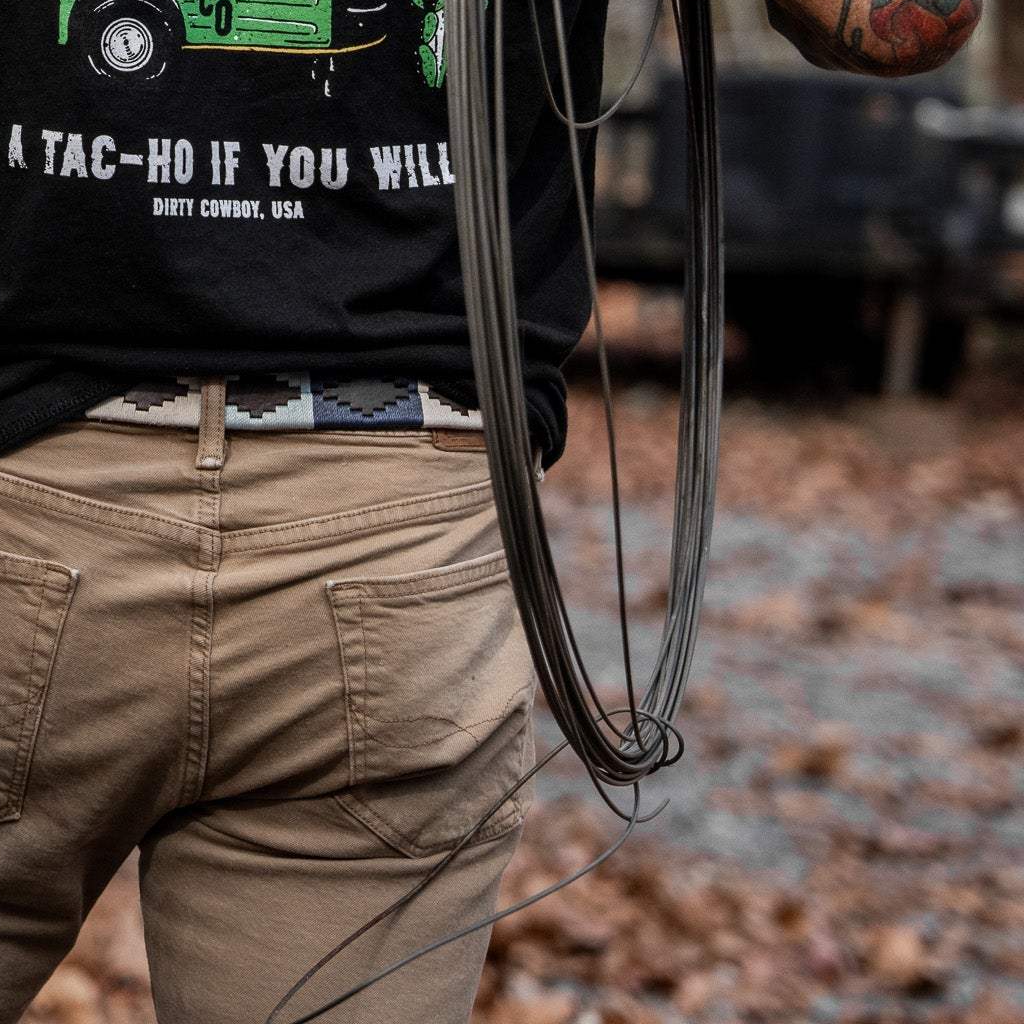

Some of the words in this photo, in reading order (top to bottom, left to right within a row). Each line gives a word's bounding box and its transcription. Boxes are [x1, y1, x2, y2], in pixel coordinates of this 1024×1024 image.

[41, 128, 194, 185] TAC-HO
[210, 141, 241, 186] IF
[262, 143, 349, 190] YOU
[369, 141, 457, 190] WILL
[152, 197, 195, 217] DIRTY
[200, 198, 265, 220] COWBOY,
[271, 200, 305, 220] USA
